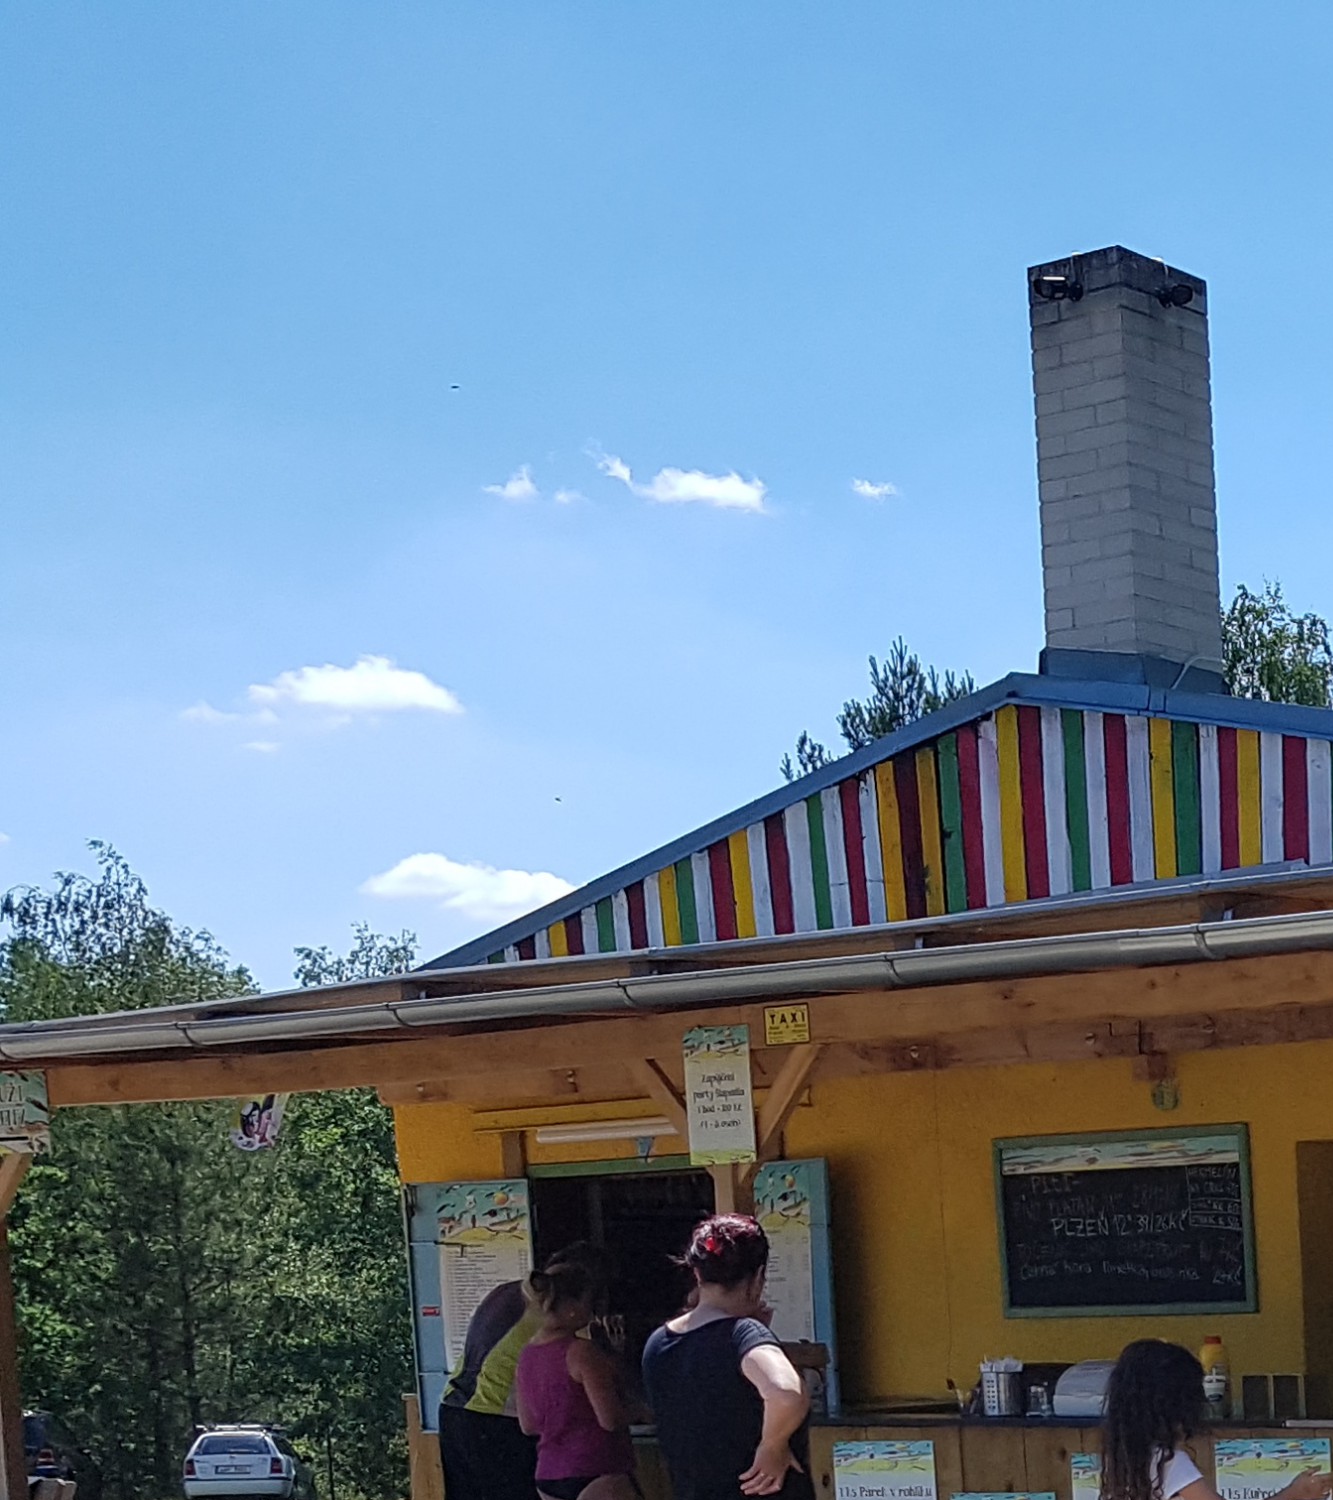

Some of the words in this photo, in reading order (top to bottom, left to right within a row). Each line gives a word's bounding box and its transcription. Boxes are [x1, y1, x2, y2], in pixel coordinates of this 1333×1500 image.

[769, 1011, 805, 1025] TAXI
[845, 1486, 857, 1498] ks
[859, 1485, 886, 1498] Párek
[1228, 1487, 1241, 1500] ks
